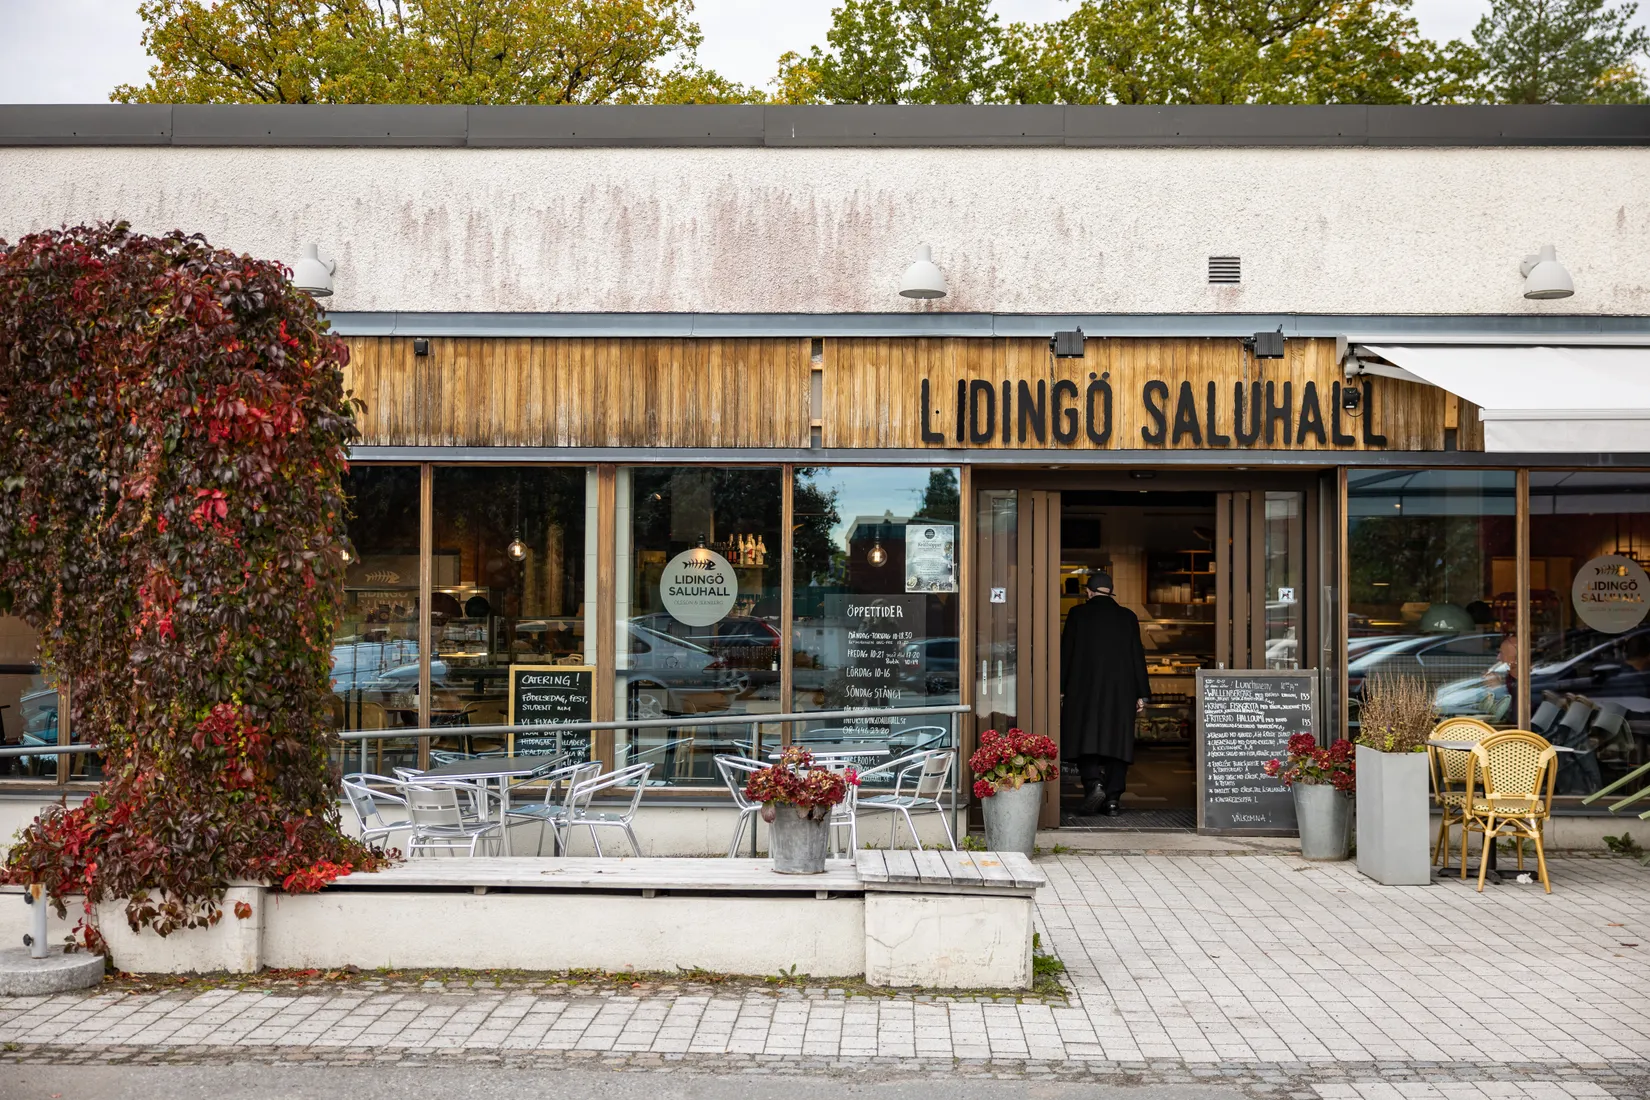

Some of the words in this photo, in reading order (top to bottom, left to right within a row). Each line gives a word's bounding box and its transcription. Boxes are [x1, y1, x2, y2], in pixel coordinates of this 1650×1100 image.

[921, 371, 1113, 445] LIDINGÖ
[1141, 379, 1388, 446] SALUHALL
[675, 573, 724, 585] LIDINGÖ
[1587, 579, 1638, 591] LIDINGÖ
[669, 586, 731, 596] SALUHALL
[1580, 593, 1645, 603] SALUHALL
[847, 604, 903, 618] ÖPPETTIDER
[847, 648, 868, 658] FREDAG
[846, 666, 872, 678] LÖRDAG
[521, 674, 571, 687] CATERING
[576, 672, 581, 687] !
[844, 684, 872, 698] SÖNDAG
[522, 692, 568, 705] FÖDELSEDAG,
[522, 703, 552, 711] STUDENT
